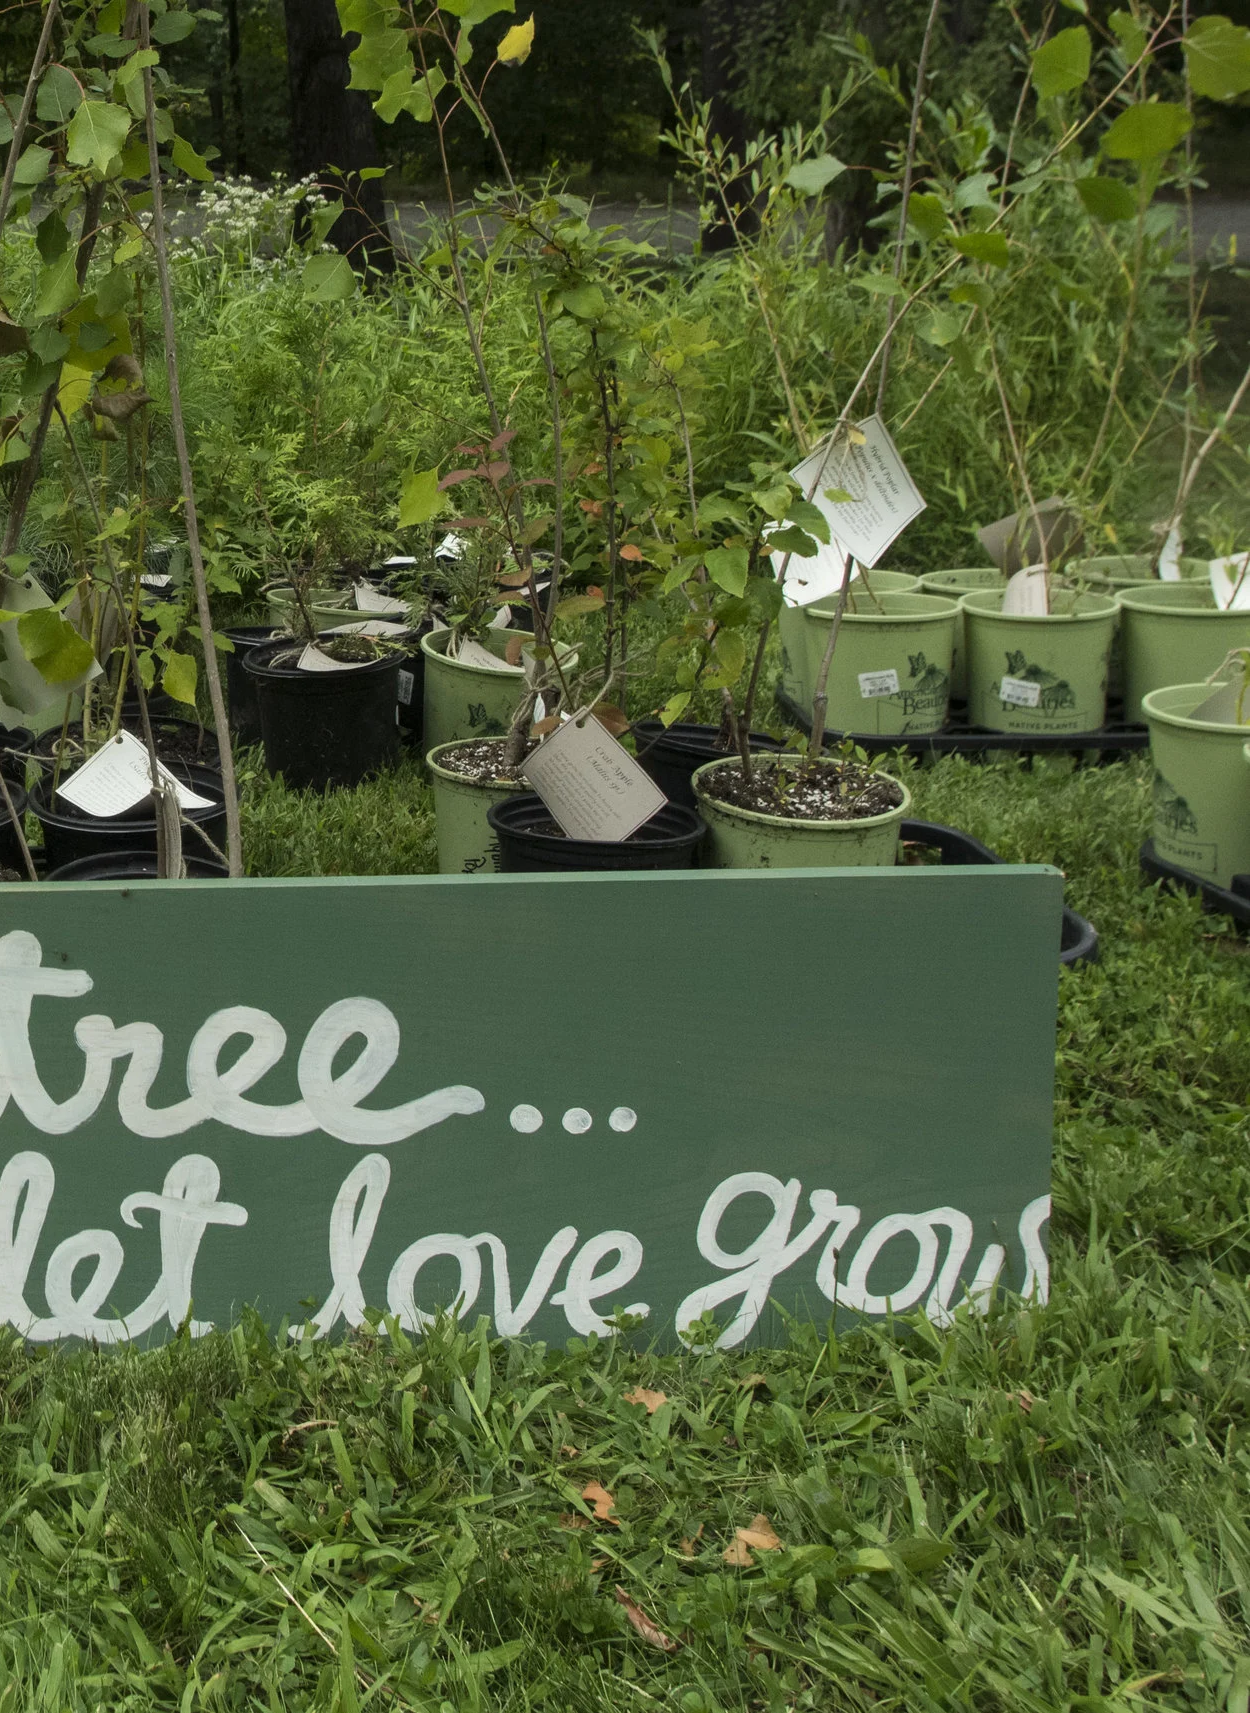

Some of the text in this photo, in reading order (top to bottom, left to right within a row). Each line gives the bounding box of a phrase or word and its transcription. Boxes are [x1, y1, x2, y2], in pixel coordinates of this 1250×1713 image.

[870, 445, 899, 495] Hybrid Poplar
[595, 746, 634, 787] Crab Apple
[288, 1153, 650, 1340] love
